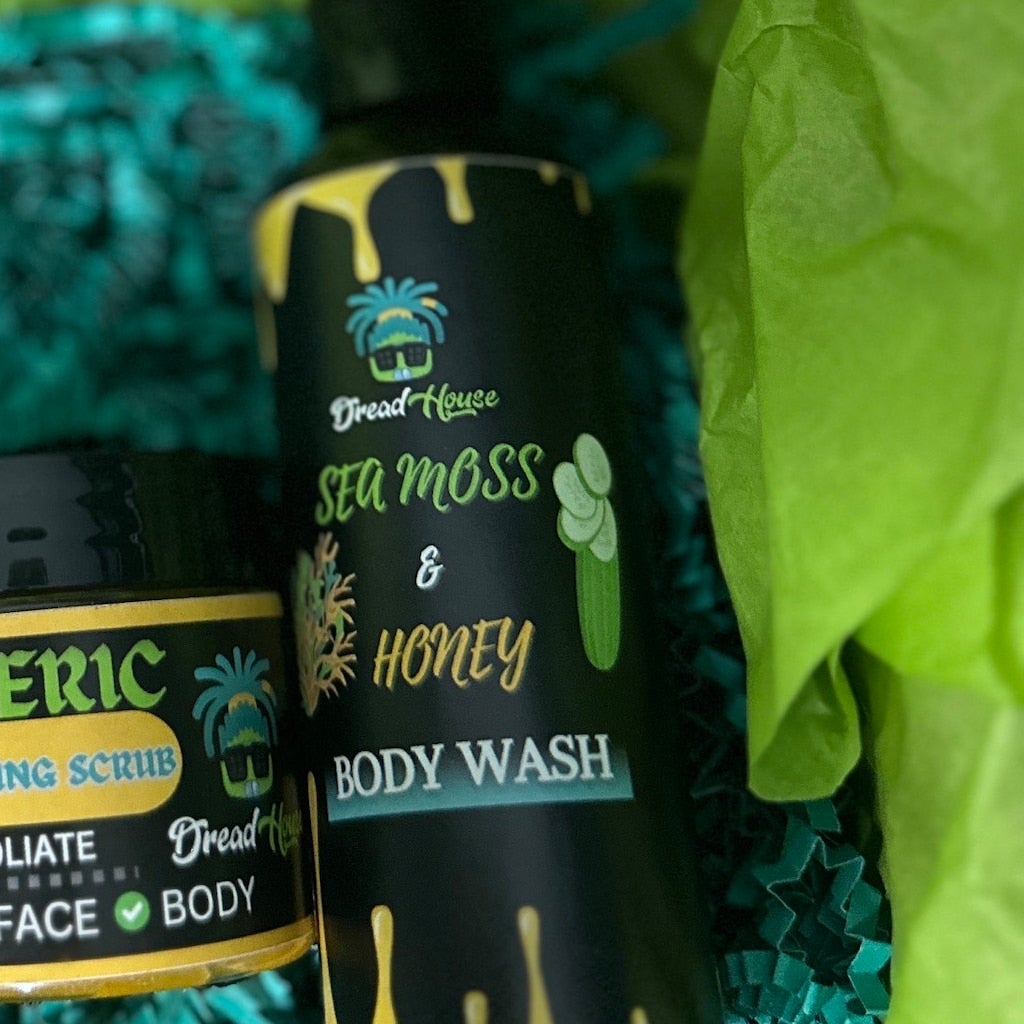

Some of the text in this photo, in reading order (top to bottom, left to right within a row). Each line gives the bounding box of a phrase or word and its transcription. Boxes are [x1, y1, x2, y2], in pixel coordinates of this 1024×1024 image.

[330, 382, 500, 433] Dread House
[315, 443, 545, 526] SEA MOSS
[416, 544, 445, 590] &
[372, 616, 535, 692] HONEY
[69, 745, 177, 786] SCRUB
[334, 733, 614, 801] BODY WASH
[168, 806, 261, 866] Dread
[162, 875, 256, 927] BODY
